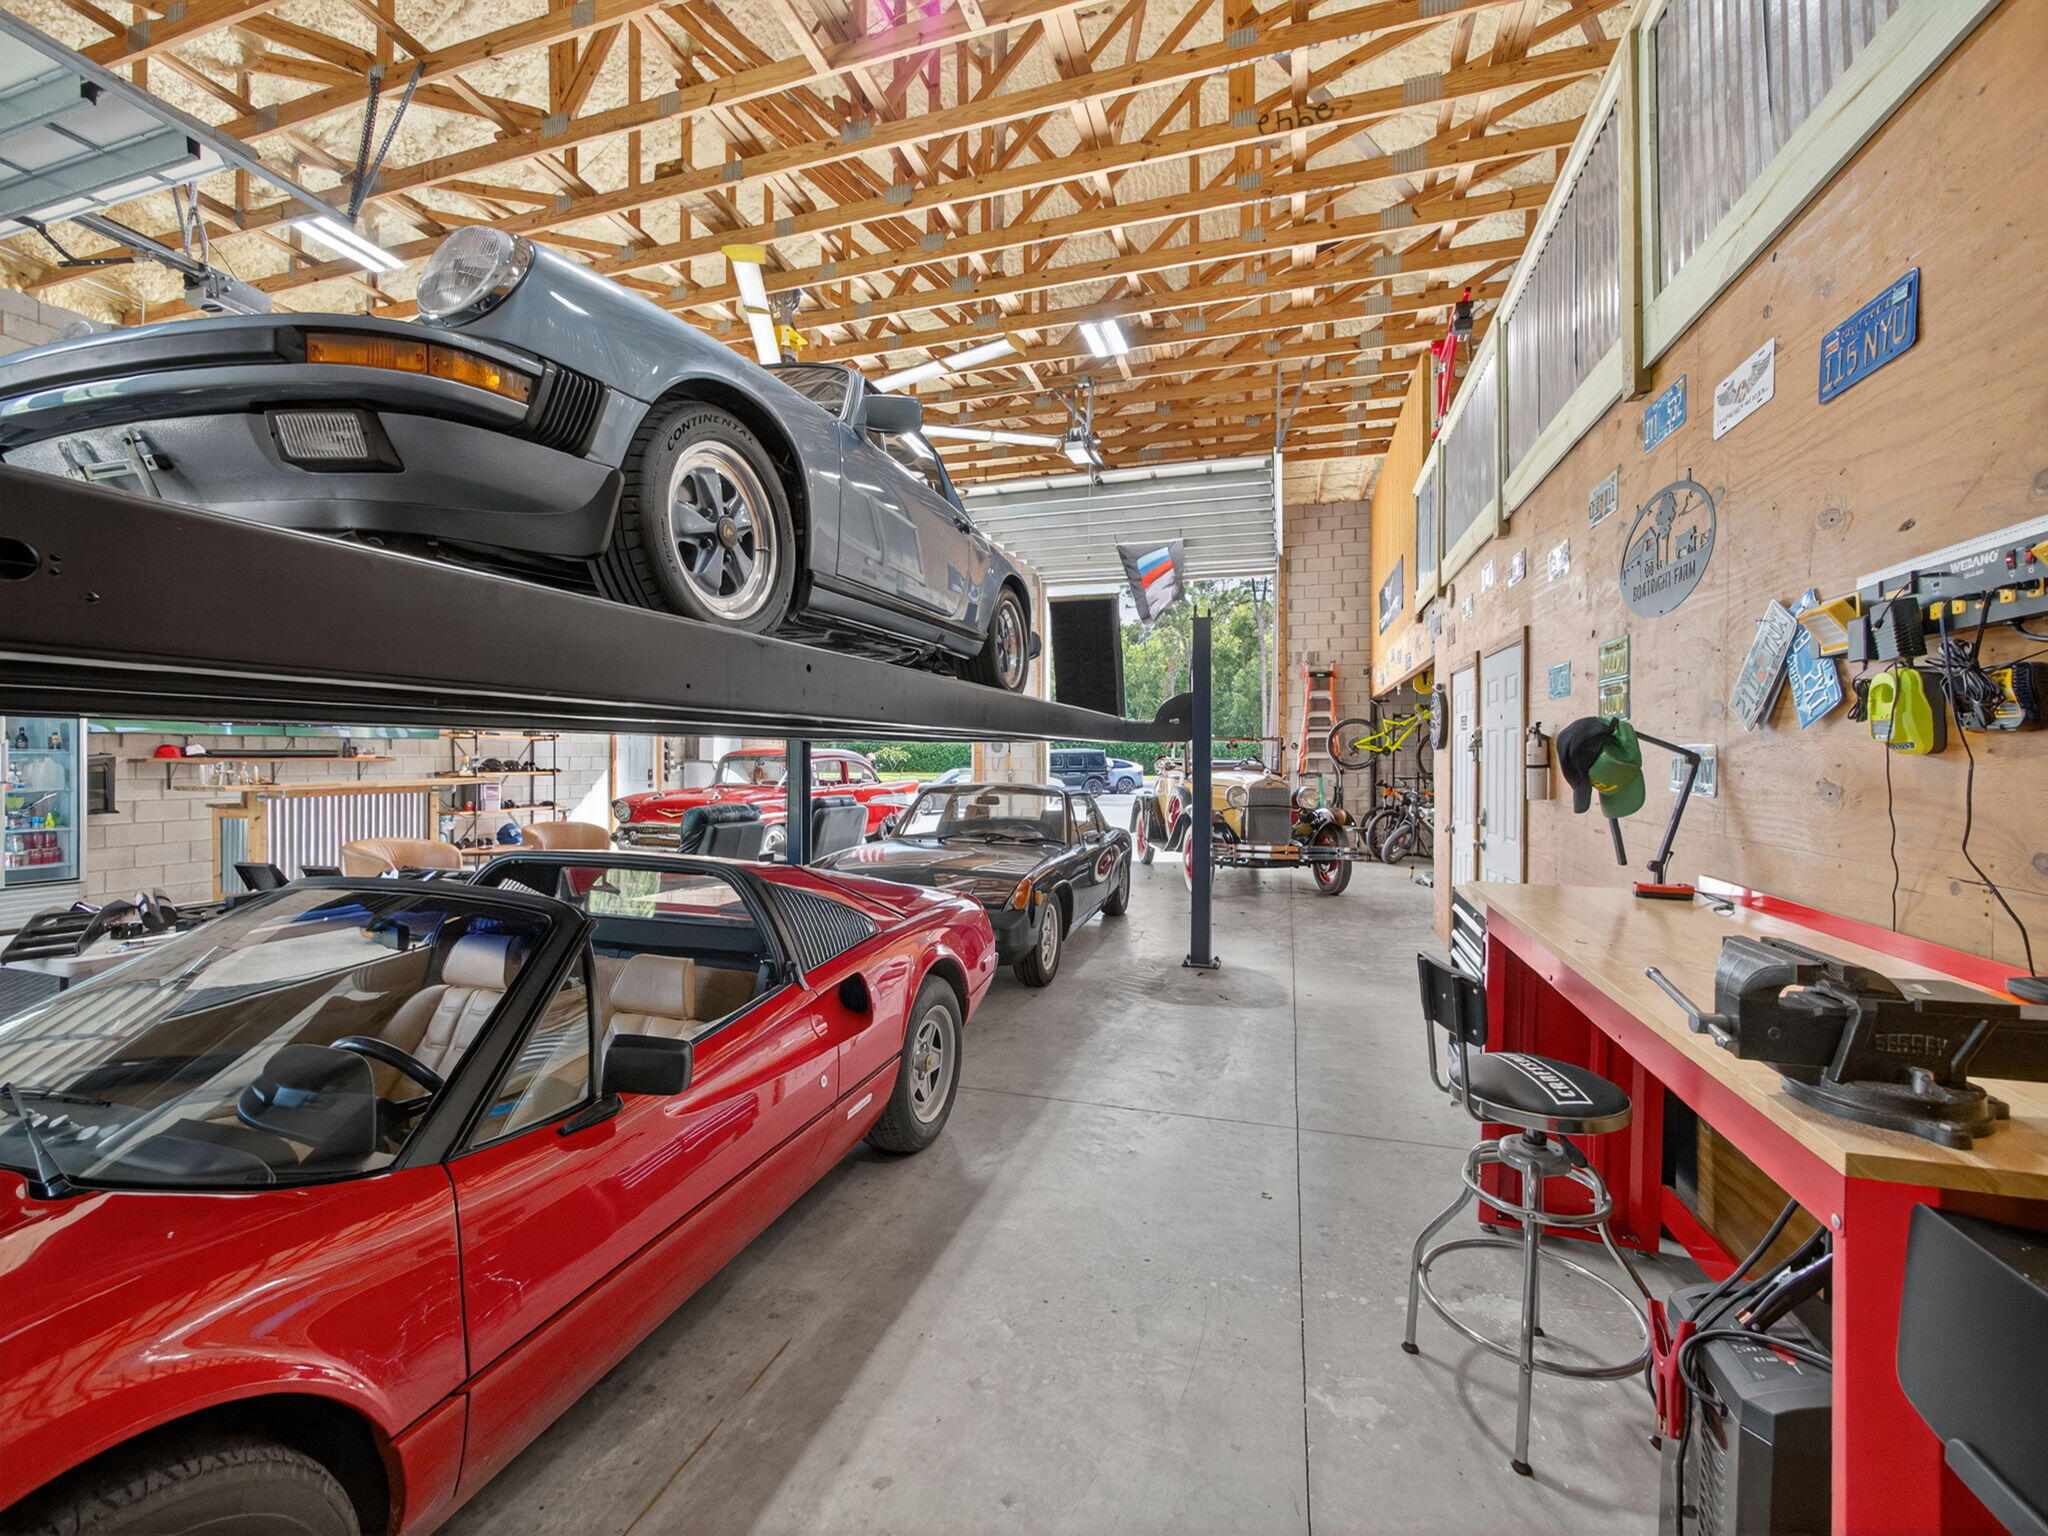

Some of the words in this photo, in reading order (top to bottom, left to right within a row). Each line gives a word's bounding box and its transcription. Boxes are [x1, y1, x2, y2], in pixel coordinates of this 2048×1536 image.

[1863, 299, 1909, 366] NYU
[667, 413, 755, 452] CONTINENTAL
[1673, 559, 1697, 585] FARM
